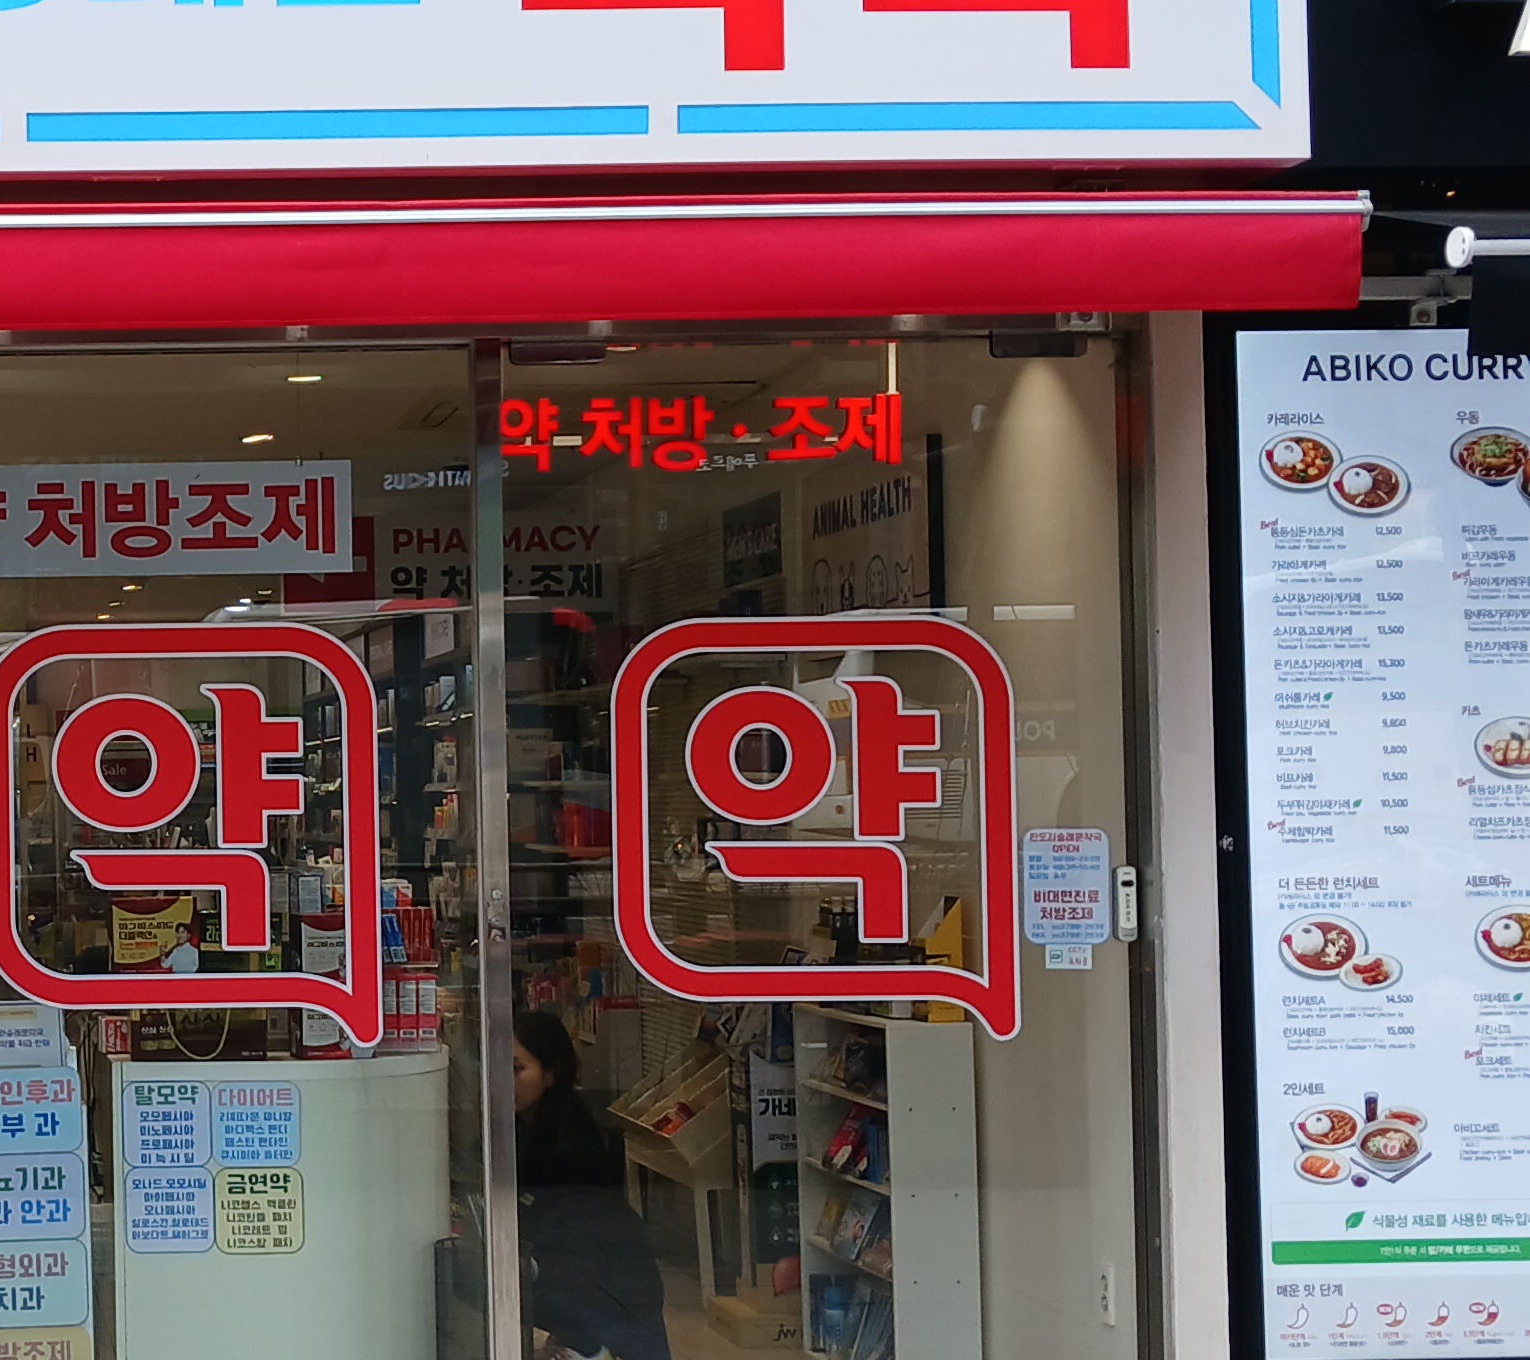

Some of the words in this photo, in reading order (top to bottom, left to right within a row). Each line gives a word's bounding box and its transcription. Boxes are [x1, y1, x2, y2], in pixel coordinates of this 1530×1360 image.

[1302, 353, 1413, 382] ABIKO
[1425, 353, 1530, 381] CURR
[1267, 412, 1325, 427] 카레라이스
[1456, 410, 1480, 425] 우동
[499, 398, 559, 472] 약
[25, 475, 337, 560] 처방조제
[813, 494, 857, 540] ANIMAL
[861, 475, 912, 524] HEALTH
[392, 525, 600, 554] PHAMACY
[390, 565, 427, 600] 약
[53, 684, 304, 951] 약
[686, 676, 941, 943] 약
[1052, 844, 1080, 853] OPEN
[1278, 877, 1289, 890] 더
[1294, 876, 1329, 890] 든든한
[1332, 876, 1380, 890] 런치세트
[1465, 875, 1512, 889] 세트메뉴
[1033, 890, 1100, 904] 비대면진료
[1040, 907, 1093, 920] 처방조제
[134, 1085, 199, 1107] 탈모약
[218, 1088, 294, 1107] 다이어트
[1283, 1083, 1325, 1096] 2인세트
[226, 1173, 291, 1195] 금연약
[20, 1197, 71, 1224] 안과
[1372, 1214, 1408, 1228] 식물성
[1412, 1213, 1446, 1228] 재료를
[1452, 1212, 1487, 1227] 사용한
[1492, 1211, 1530, 1226] 메뉴입
[1276, 1284, 1300, 1297] 매운
[1303, 1284, 1315, 1297] 맛
[1320, 1283, 1343, 1297] 단계
